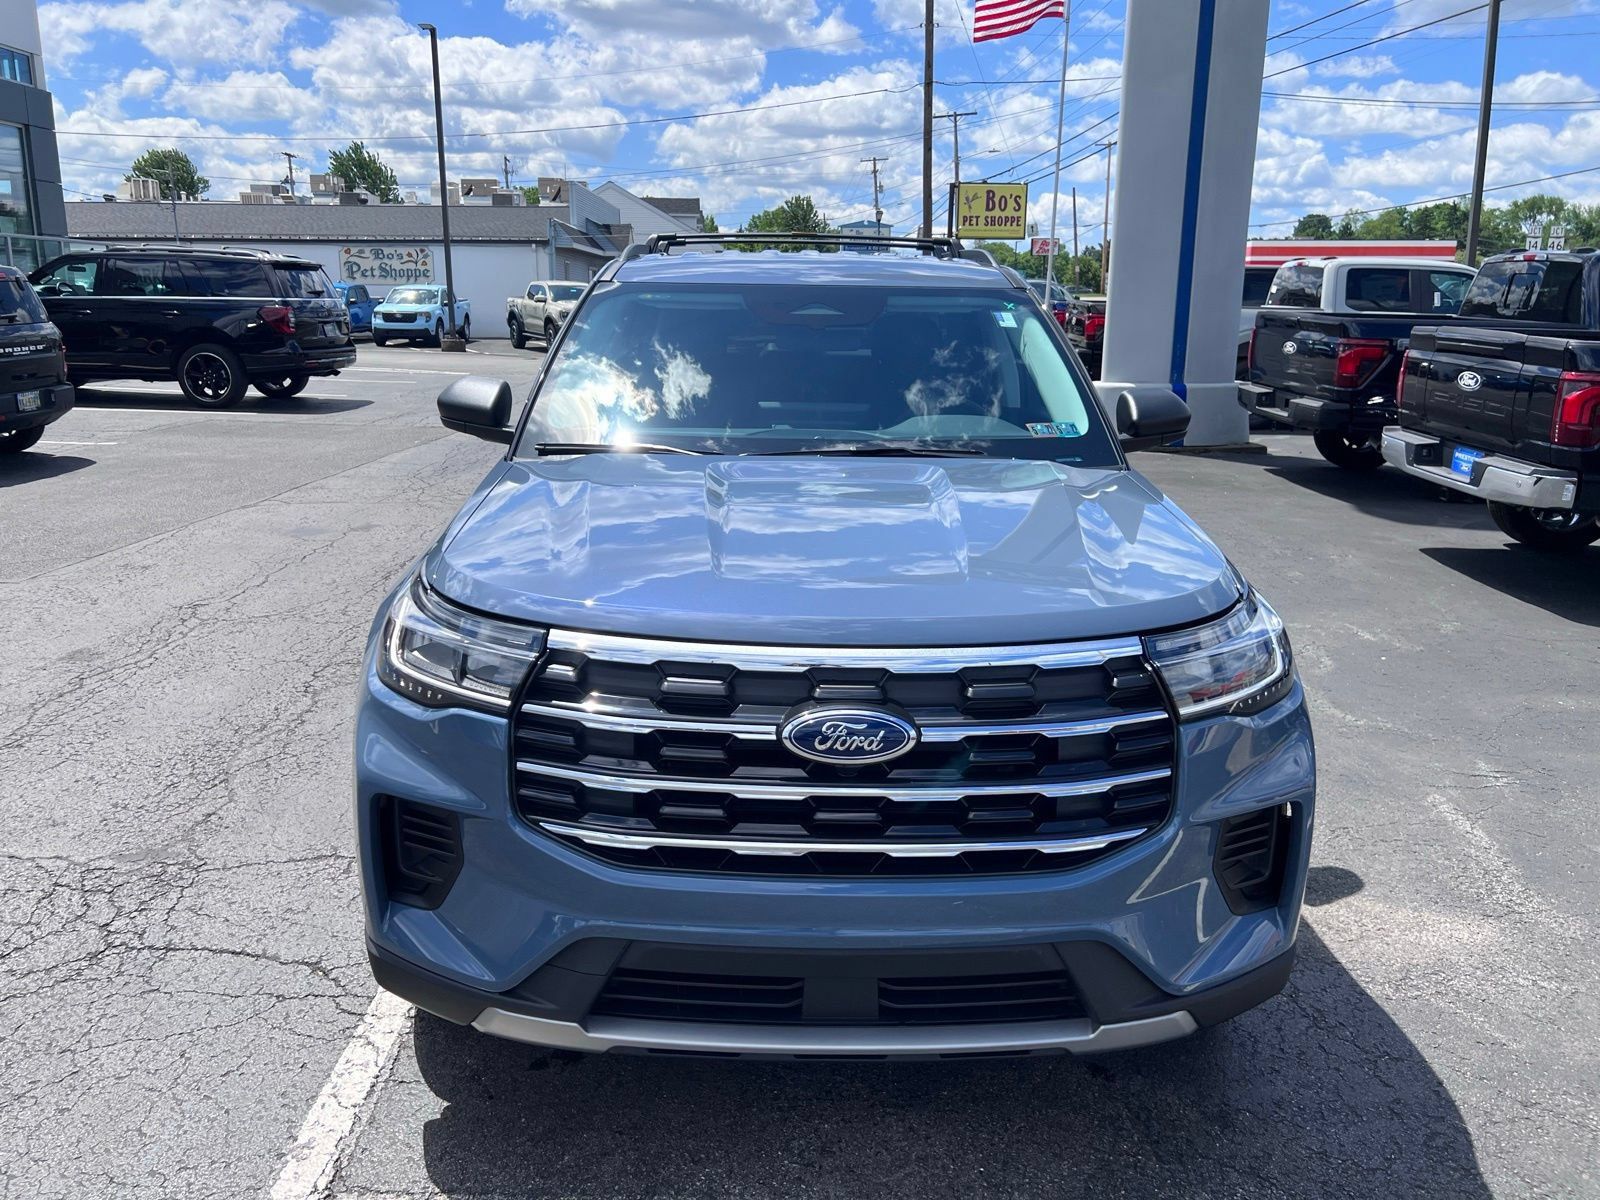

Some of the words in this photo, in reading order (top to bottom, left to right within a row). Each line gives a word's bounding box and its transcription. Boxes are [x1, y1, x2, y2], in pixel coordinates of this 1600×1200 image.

[962, 215, 980, 226] PET
[984, 215, 1022, 227] SHOPPE
[1040, 239, 1058, 247] Auo
[1528, 240, 1538, 250] 14
[1548, 240, 1563, 251] 46
[370, 248, 403, 260] Bo's
[344, 261, 376, 280] Pet
[378, 262, 431, 282] Shoppe
[813, 721, 885, 751] Ford
